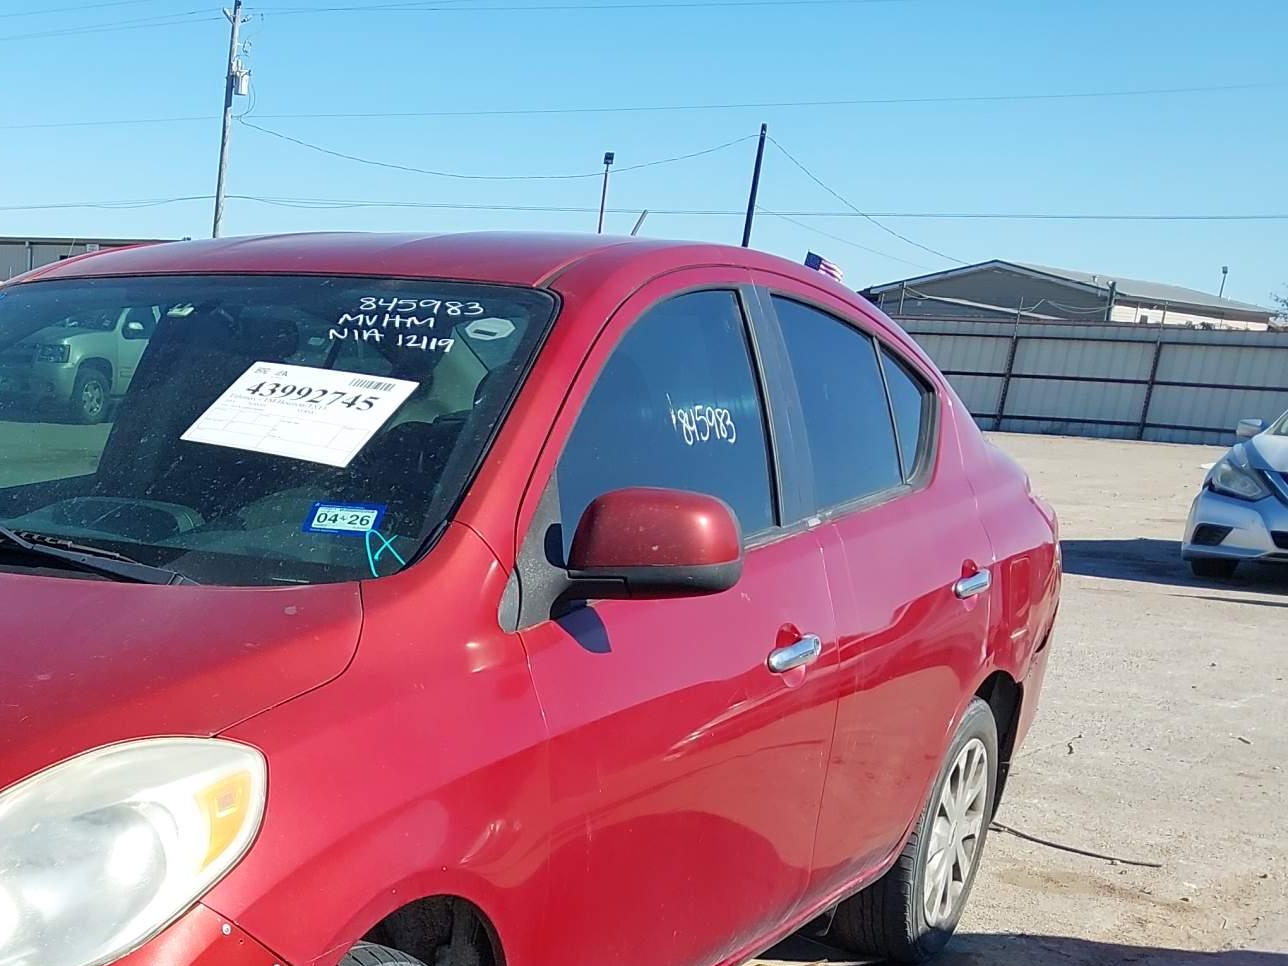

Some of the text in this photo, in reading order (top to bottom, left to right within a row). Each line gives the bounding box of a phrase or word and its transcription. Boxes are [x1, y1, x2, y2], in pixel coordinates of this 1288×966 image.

[359, 296, 485, 317] 845983
[245, 381, 381, 412] 43992745
[677, 404, 736, 446] 845983
